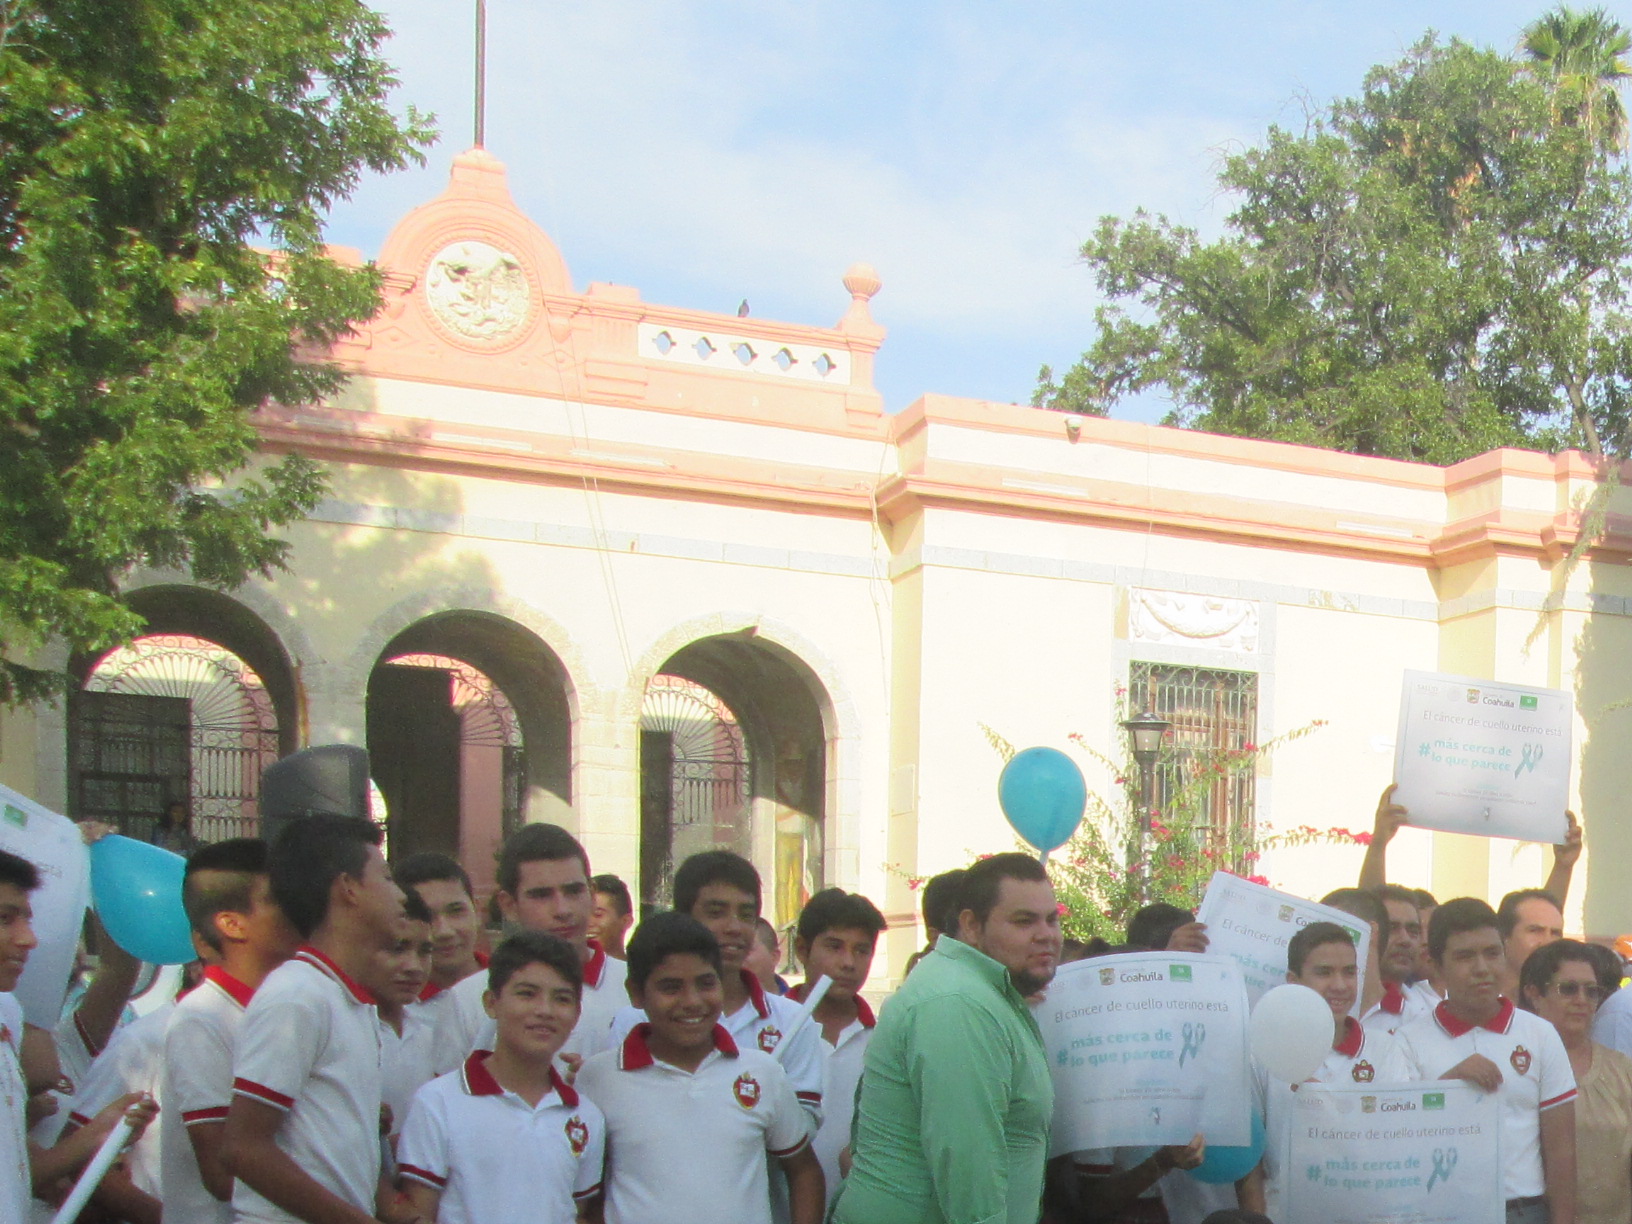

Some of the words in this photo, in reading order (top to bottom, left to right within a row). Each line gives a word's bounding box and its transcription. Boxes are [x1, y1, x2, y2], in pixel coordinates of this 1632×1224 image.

[1482, 696, 1515, 708] Coahuila
[1423, 710, 1432, 720] El
[1434, 711, 1465, 724] cáncer
[1467, 718, 1480, 726] de
[1482, 720, 1510, 731] cuello
[1512, 722, 1543, 735] uterino
[1545, 728, 1562, 737] está
[1434, 737, 1459, 750] más
[1463, 742, 1495, 755] cerca
[1498, 746, 1512, 756] de
[1431, 752, 1442, 763] lo
[1445, 754, 1468, 768] que
[1471, 758, 1511, 772] parece
[1120, 972, 1163, 983] Coahuila
[1054, 1011, 1064, 1023] El
[1065, 1003, 1102, 1021] cáncer
[1107, 1001, 1122, 1013] de
[1126, 998, 1163, 1010] cuello
[1166, 998, 1204, 1010] uterino
[1206, 1000, 1228, 1012] está
[1071, 1030, 1103, 1049] más
[1107, 1030, 1149, 1044] cerca
[1155, 1028, 1172, 1042] de
[1070, 1054, 1084, 1068] lo
[1088, 1049, 1118, 1066] que
[1122, 1049, 1174, 1065] parece
[1380, 1100, 1417, 1112] Coahuila
[1308, 1128, 1318, 1138] El
[1321, 1128, 1361, 1140] cáncer
[1365, 1128, 1379, 1139] de
[1383, 1127, 1413, 1140] cuello
[1416, 1126, 1456, 1139] uterino
[1458, 1124, 1481, 1136] está
[1326, 1156, 1357, 1170] más
[1363, 1159, 1400, 1171] cerca
[1404, 1156, 1420, 1169] de
[1324, 1174, 1338, 1187] lo
[1343, 1176, 1370, 1190] que
[1375, 1175, 1421, 1190] parece
